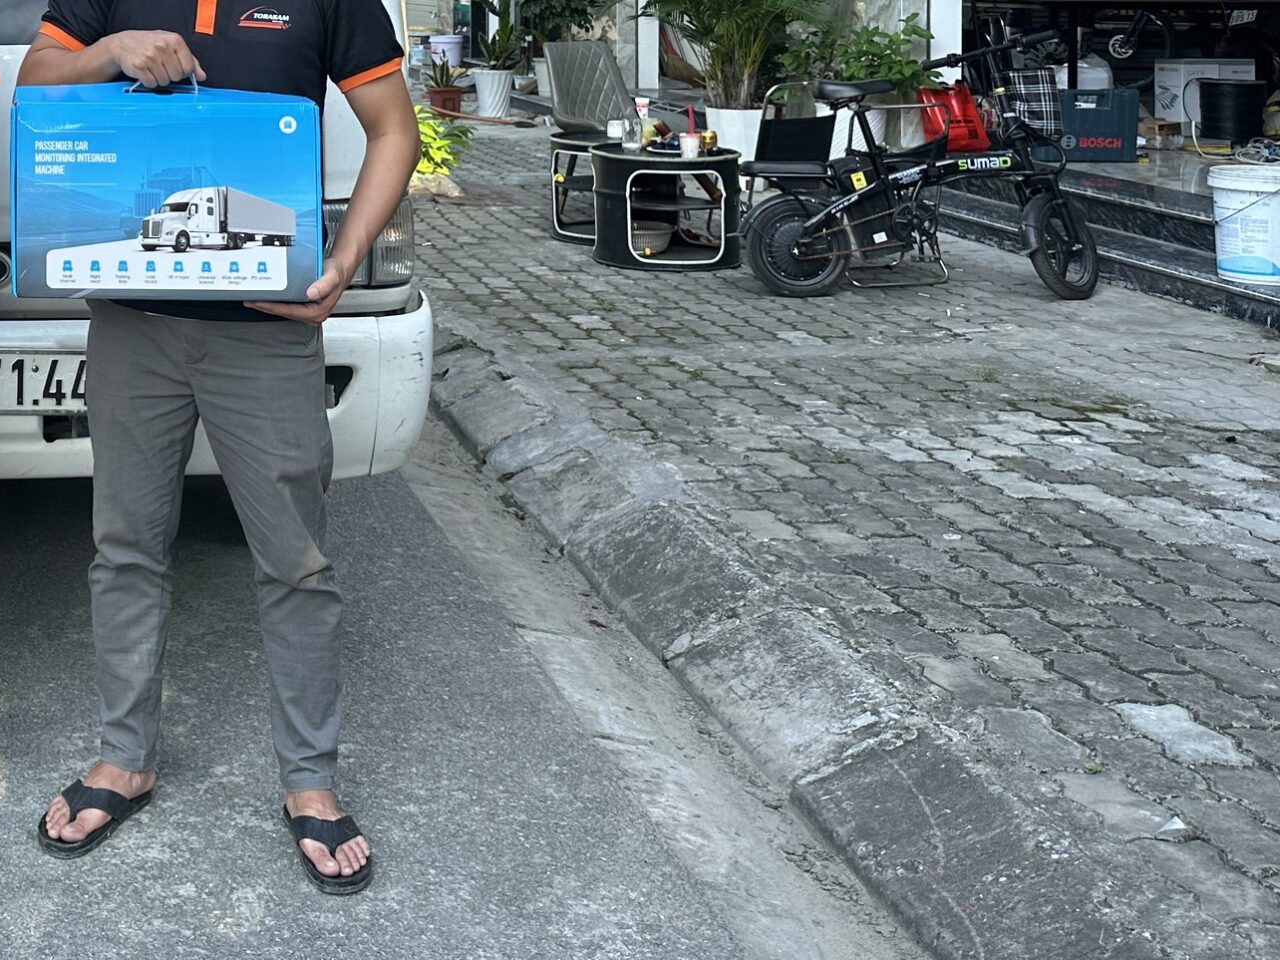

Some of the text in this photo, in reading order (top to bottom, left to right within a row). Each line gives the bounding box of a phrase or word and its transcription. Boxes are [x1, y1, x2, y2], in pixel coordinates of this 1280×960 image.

[35, 141, 88, 150] PASSENGER CAR
[1080, 137, 1122, 148] BOSCH
[35, 153, 117, 163] MONITORING INTEGRATED
[35, 165, 65, 175] MACHINE
